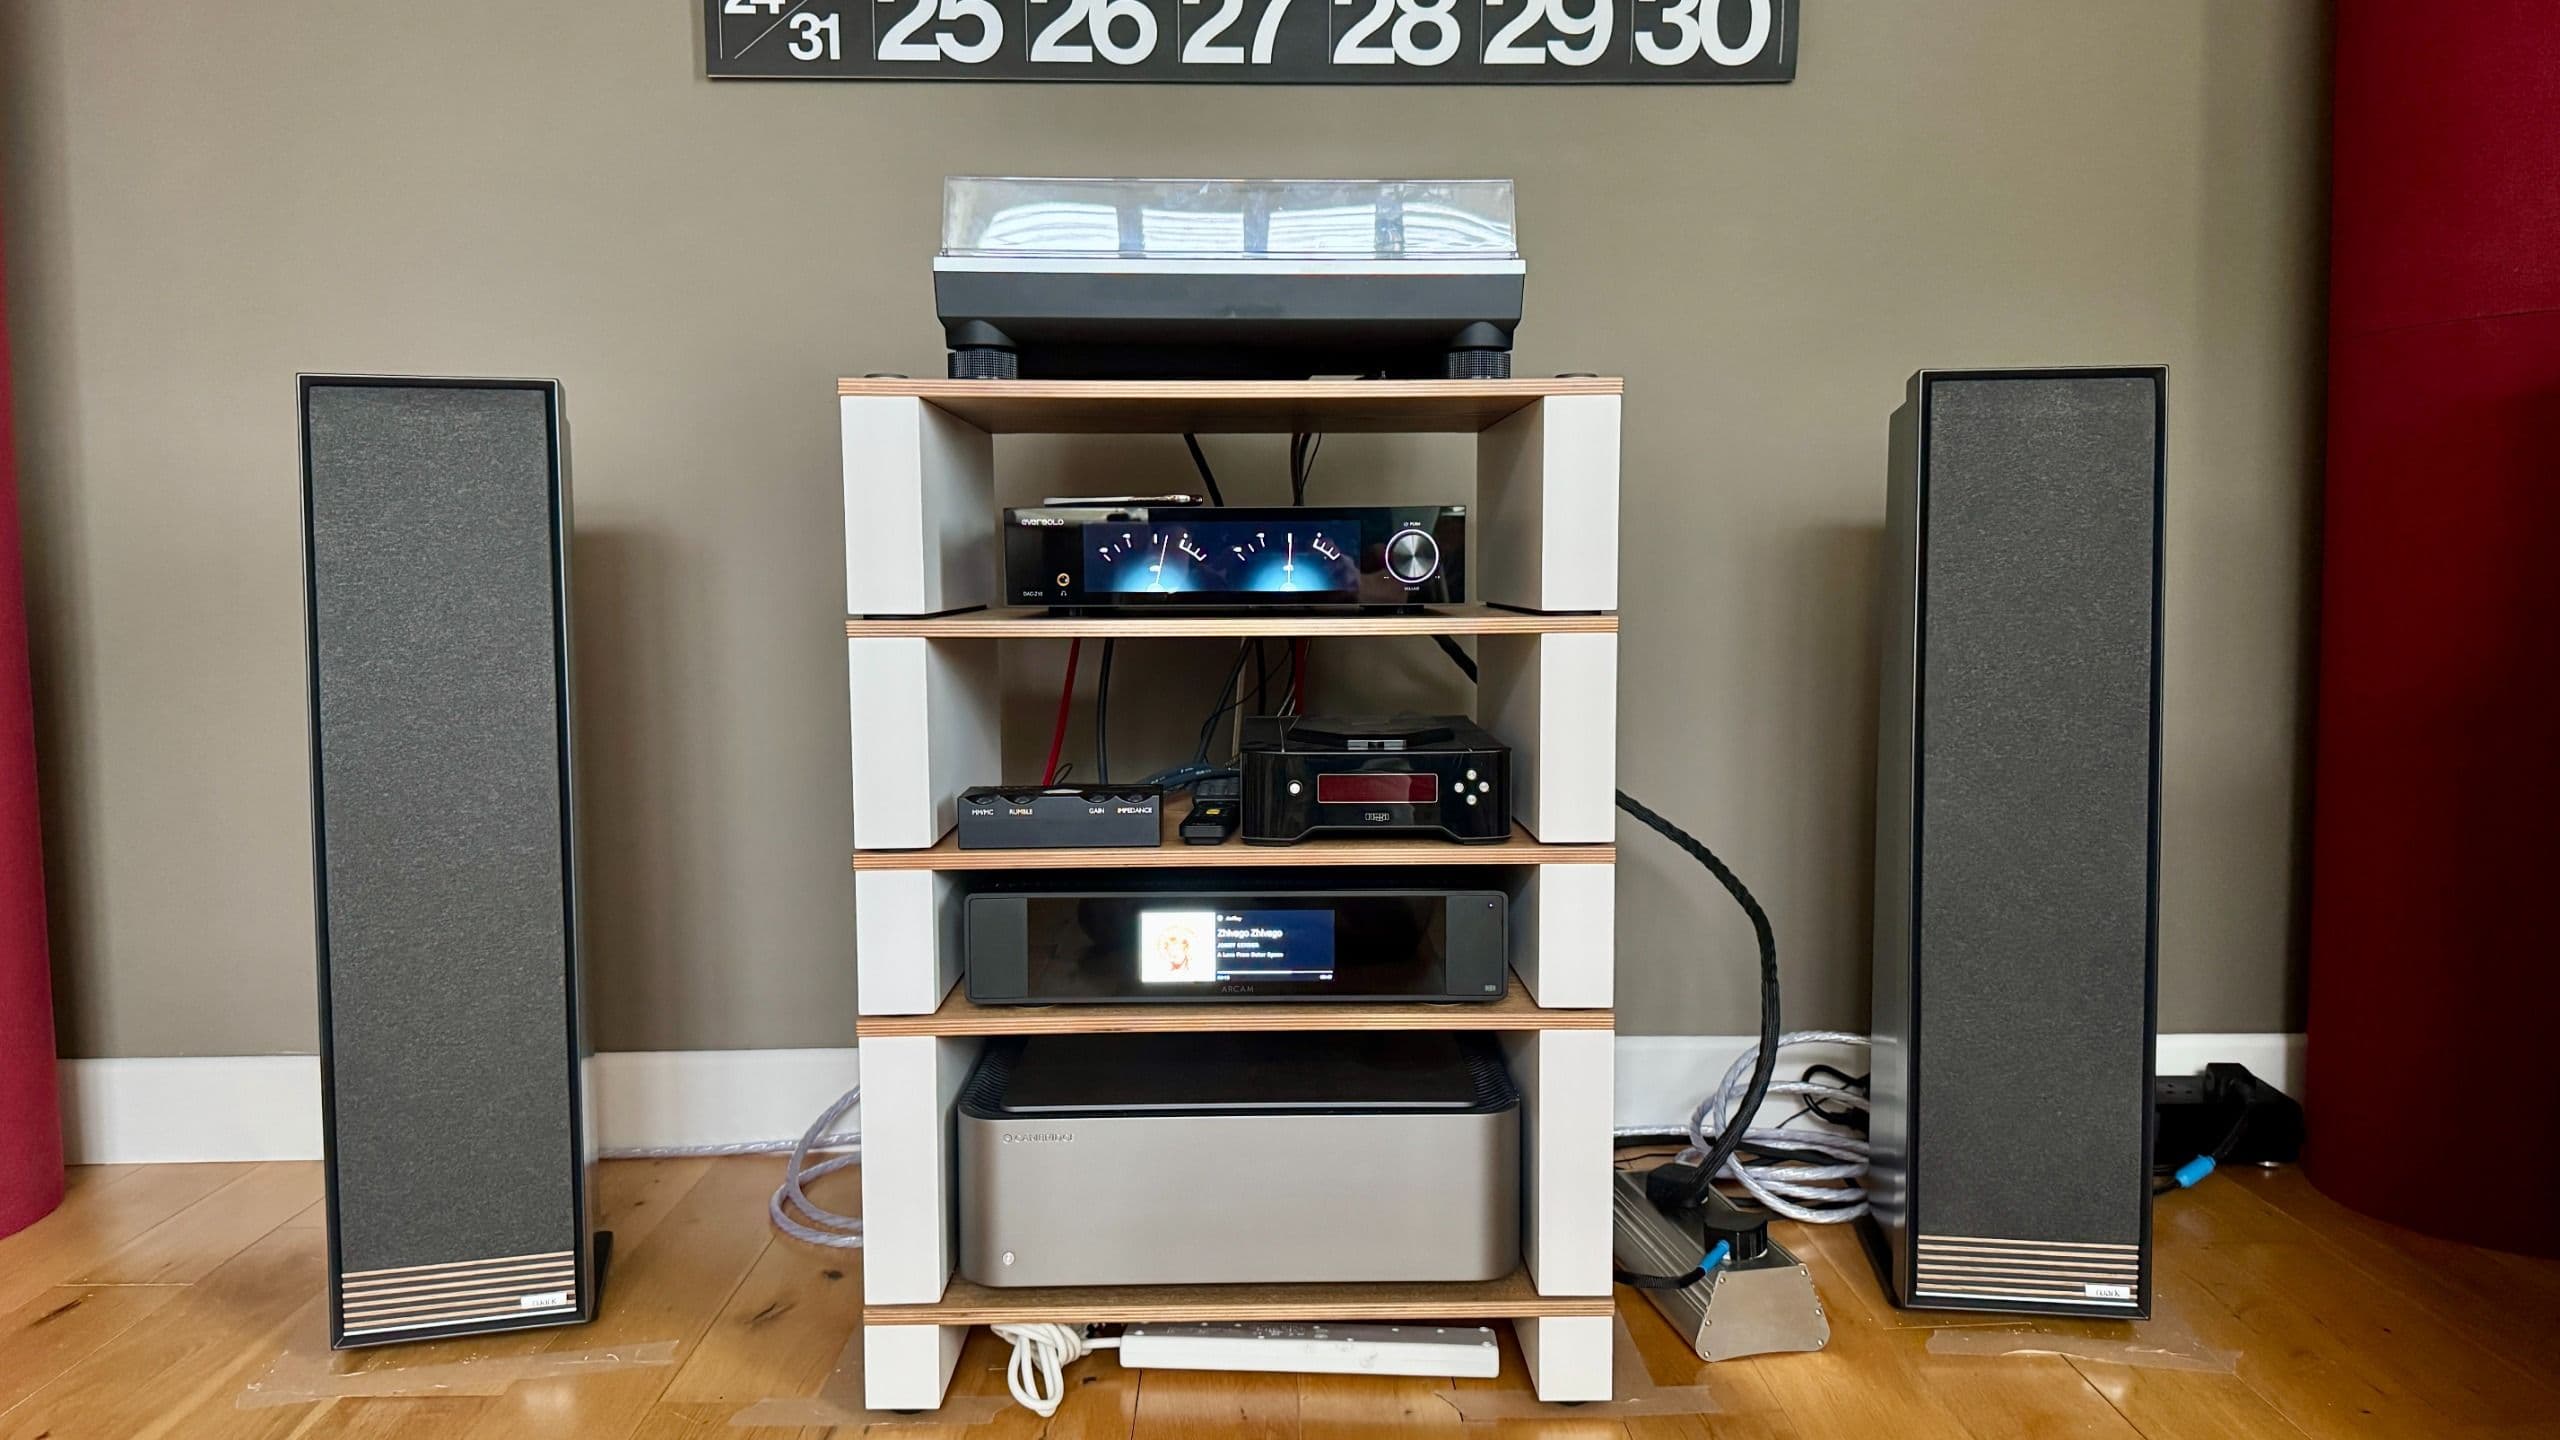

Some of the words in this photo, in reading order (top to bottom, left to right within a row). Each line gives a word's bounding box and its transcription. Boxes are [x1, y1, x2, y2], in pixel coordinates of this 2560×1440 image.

[787, 13, 840, 61] 31
[877, 0, 1004, 64] 25
[1030, 0, 1158, 65] 26
[1182, 0, 1292, 65] 27
[1332, 0, 1461, 66] 28
[1483, 0, 1614, 66] 29
[1634, 0, 1771, 66] 30
